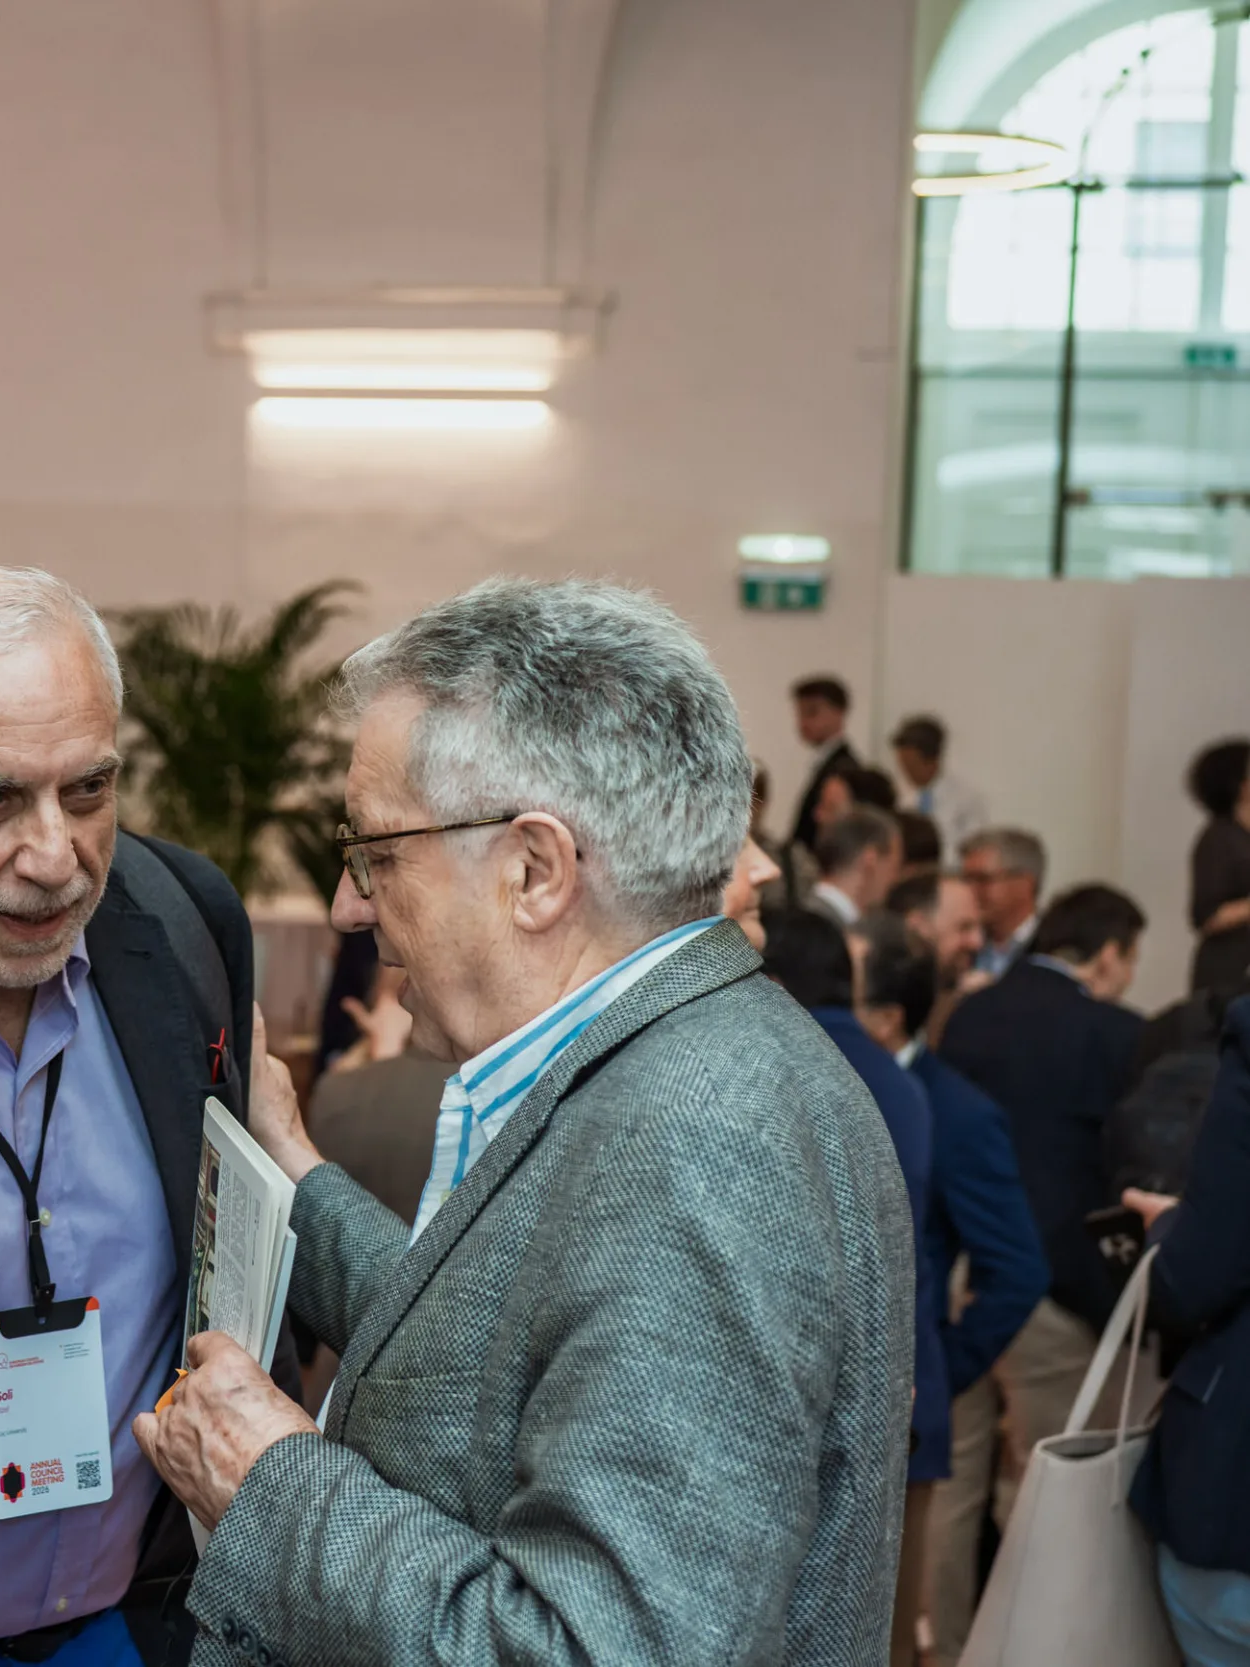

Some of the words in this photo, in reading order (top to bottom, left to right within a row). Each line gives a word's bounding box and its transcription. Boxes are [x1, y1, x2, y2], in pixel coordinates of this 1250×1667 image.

[30, 1458, 62, 1470] ANNUAL
[30, 1467, 64, 1478] COUNCIL
[31, 1475, 65, 1487] MEETING
